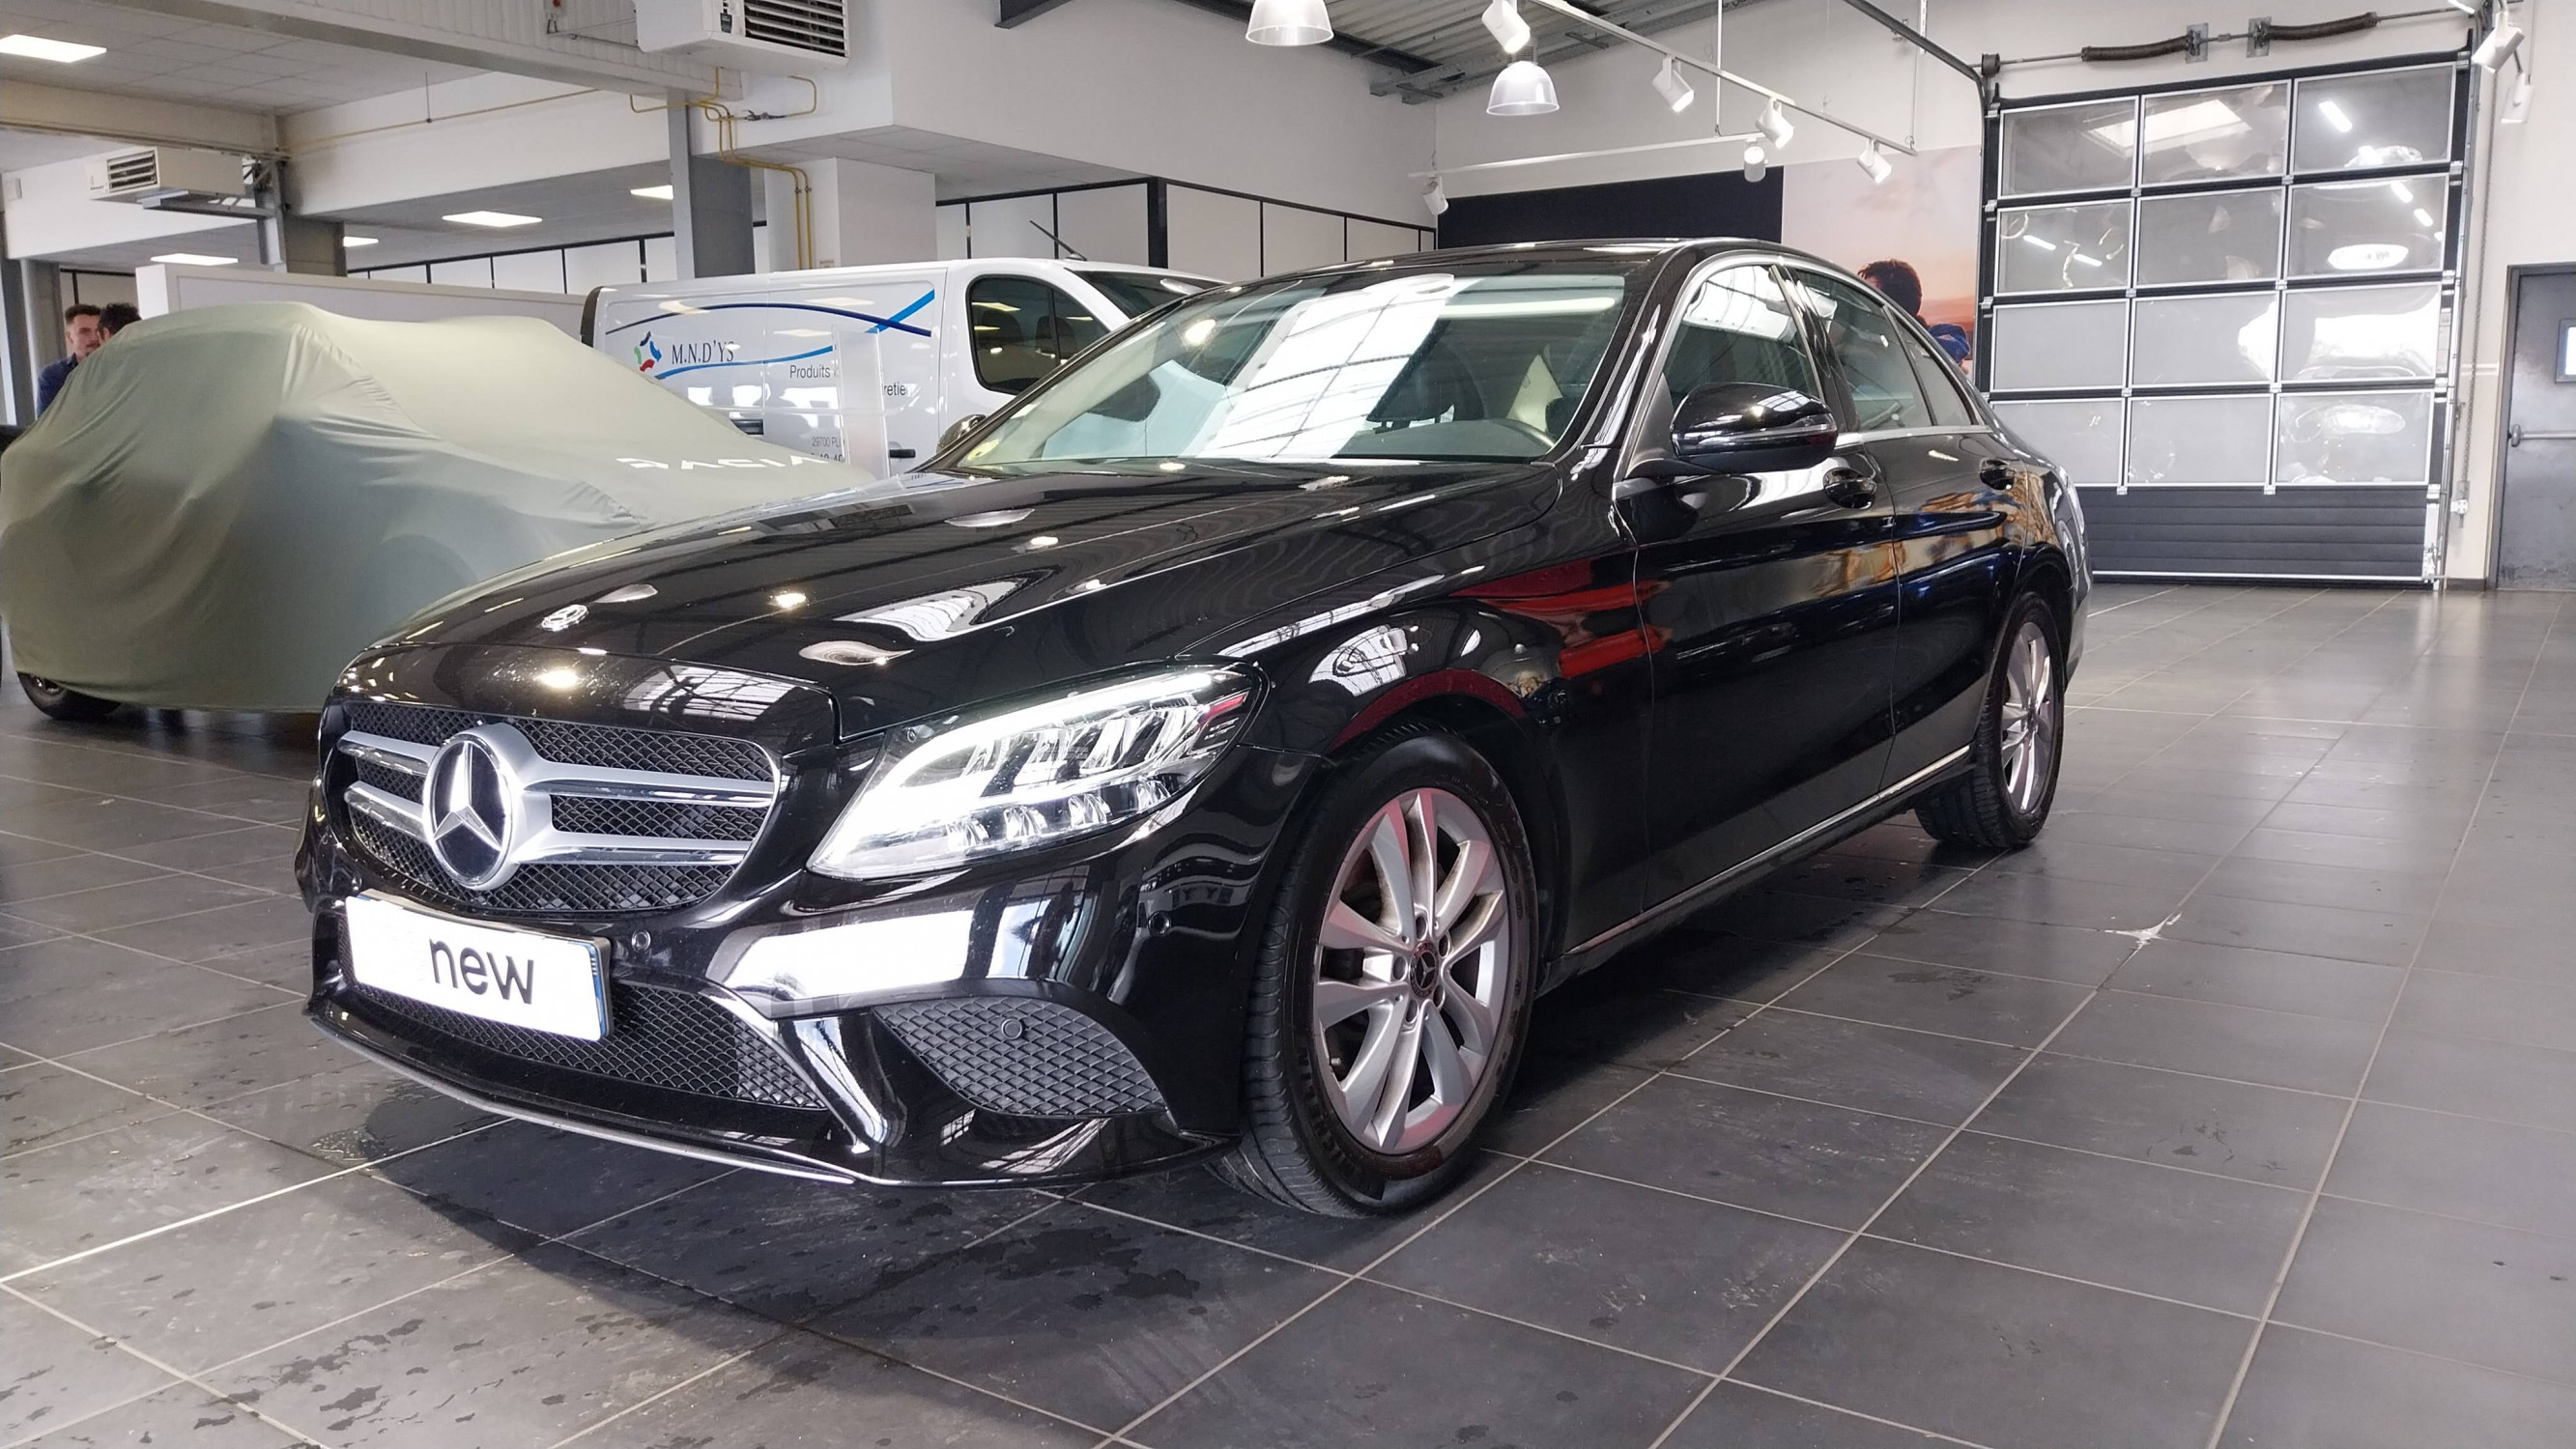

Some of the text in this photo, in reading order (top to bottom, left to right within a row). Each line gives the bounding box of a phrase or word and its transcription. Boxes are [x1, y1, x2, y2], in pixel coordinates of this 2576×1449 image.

[789, 364, 831, 378] Produits
[883, 381, 908, 396] retie
[812, 436, 830, 447] 29700
[429, 938, 534, 1005] new
